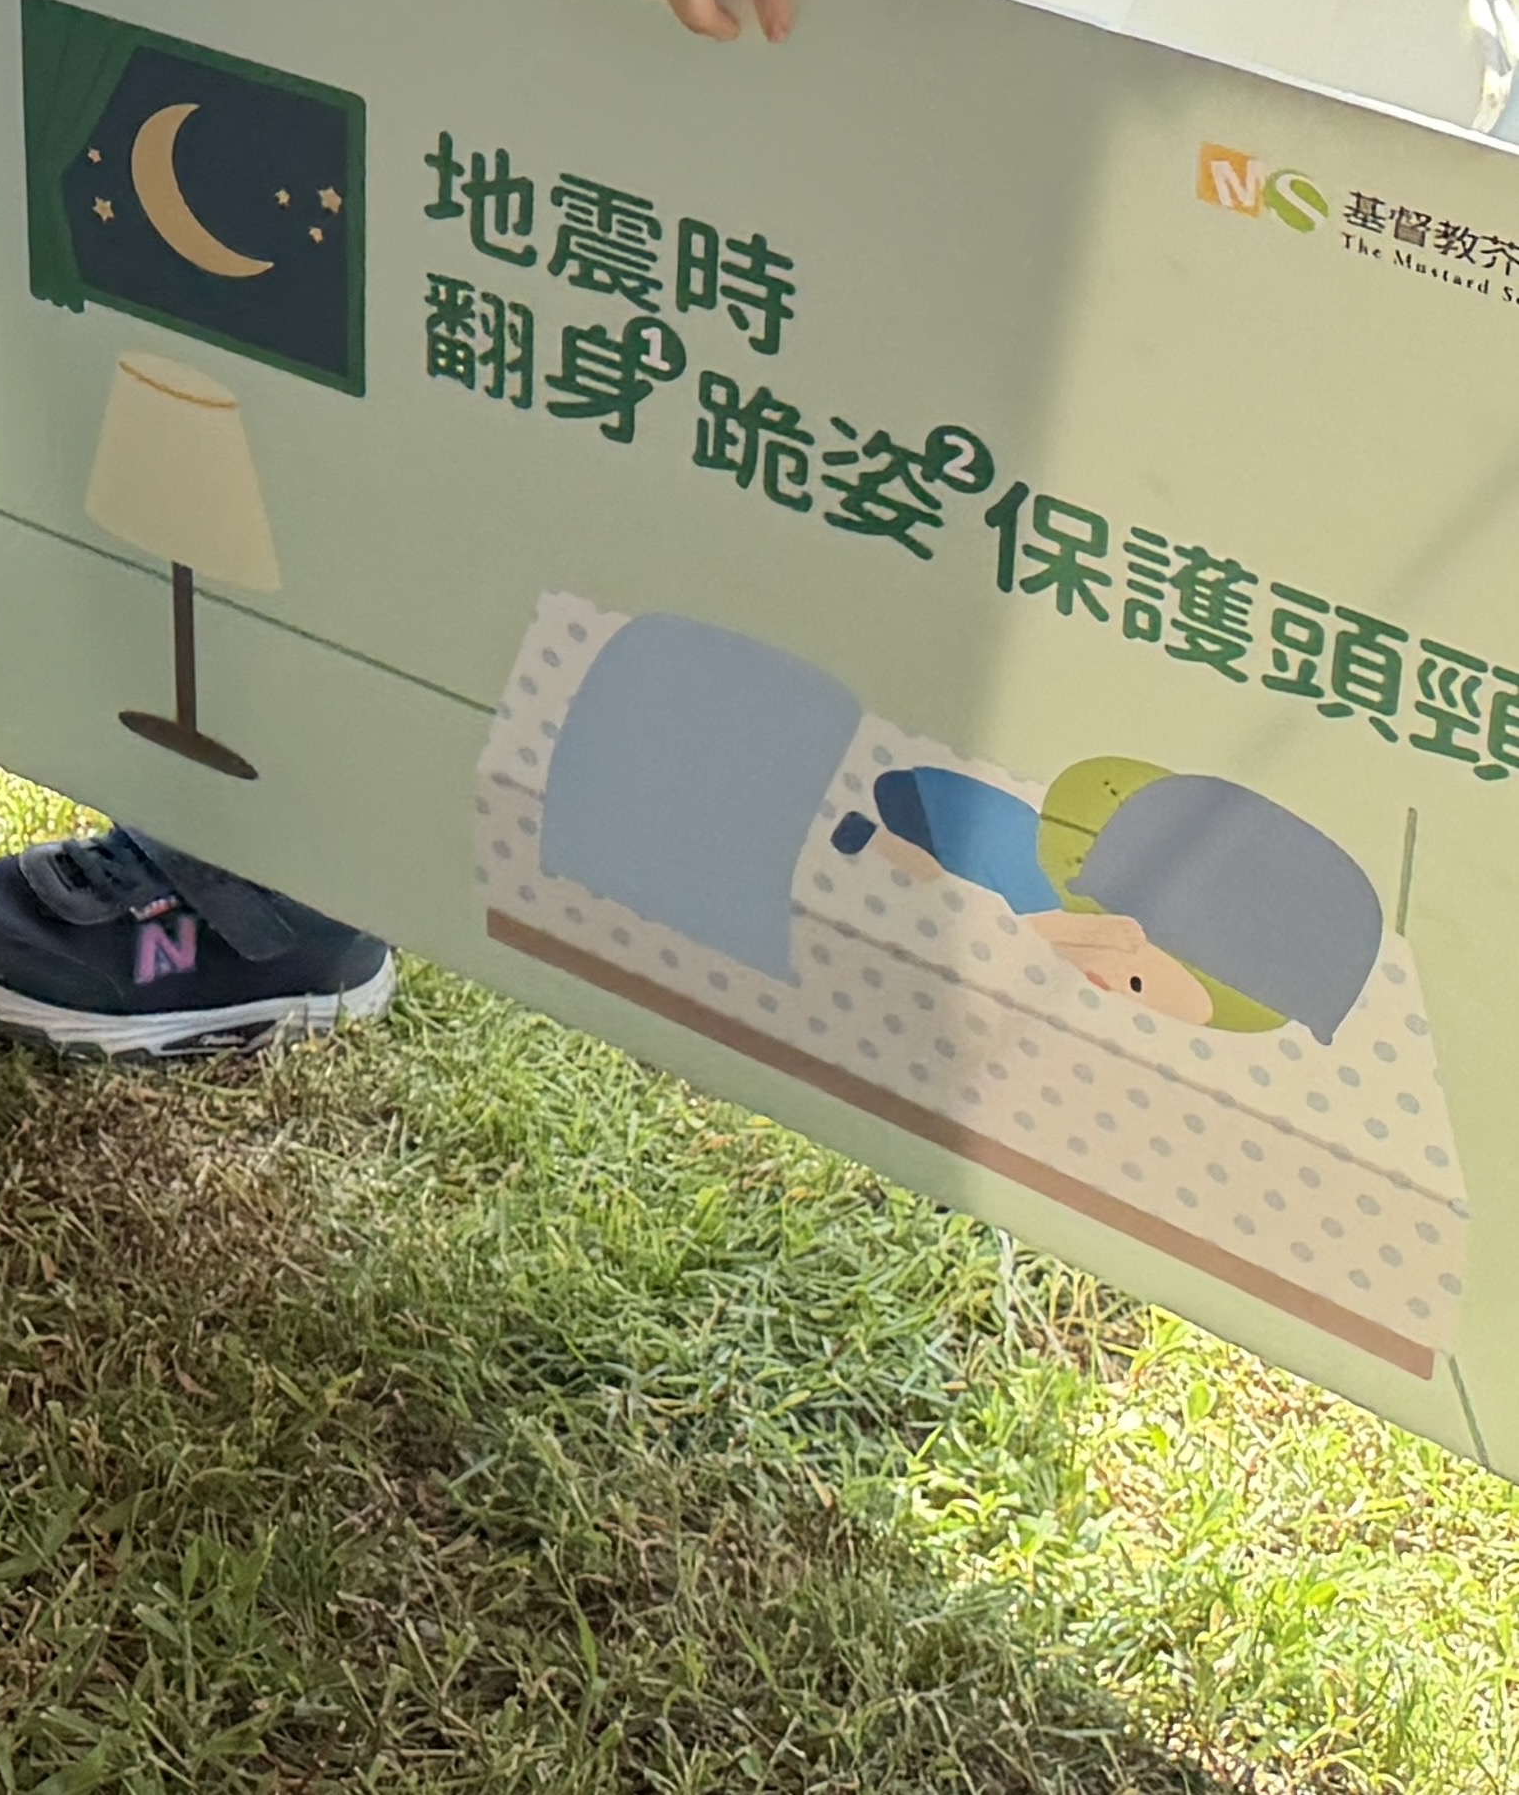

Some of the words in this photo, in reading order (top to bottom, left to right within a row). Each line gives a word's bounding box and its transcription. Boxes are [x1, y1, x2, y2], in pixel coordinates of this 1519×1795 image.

[424, 131, 797, 356] 地震時
[1341, 231, 1382, 260] The
[1393, 250, 1489, 295] Mustard
